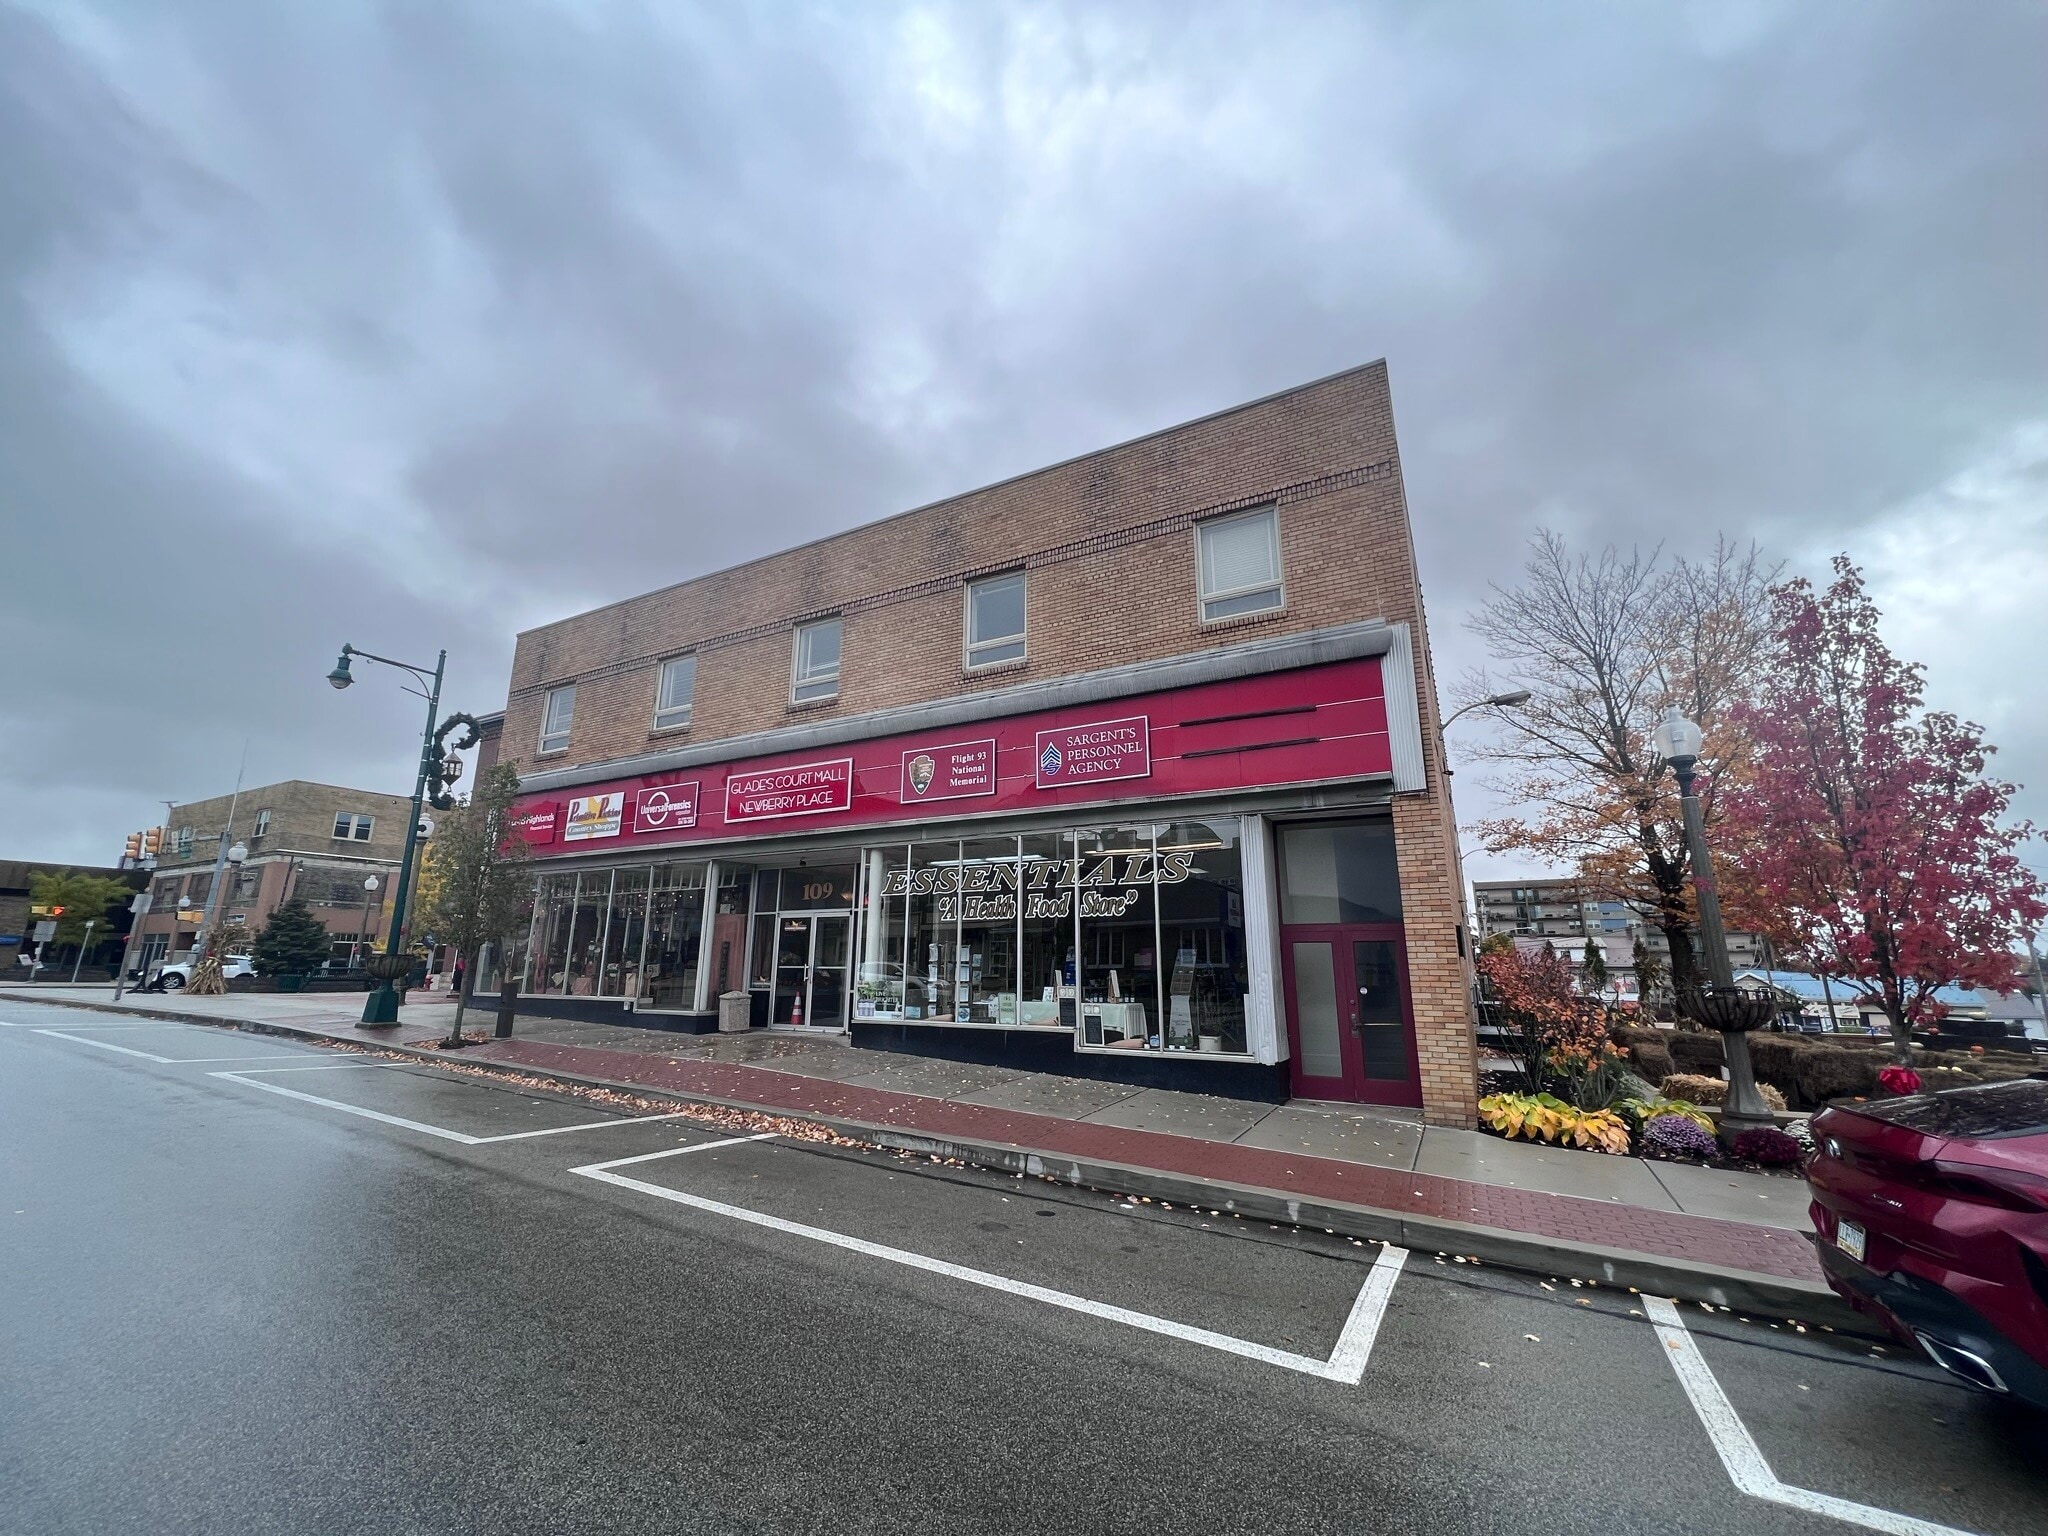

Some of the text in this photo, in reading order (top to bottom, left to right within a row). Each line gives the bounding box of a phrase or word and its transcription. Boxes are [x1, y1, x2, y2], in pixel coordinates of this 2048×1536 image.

[1067, 727, 1136, 747] SARGENT'S
[951, 751, 987, 764] Flight 93
[1067, 741, 1143, 761] PERSONNEL
[952, 763, 985, 775] National
[1067, 758, 1122, 775] AGENCY
[775, 771, 813, 789] COURT
[814, 768, 847, 783] MALL
[949, 775, 987, 787] Memorial
[739, 790, 834, 814] NEWBERRY PLACE
[568, 823, 617, 833] Country Shoppe
[880, 851, 1194, 897] ESSENTIALS
[801, 882, 834, 901] 109
[962, 893, 1017, 921] Health
[1025, 891, 1072, 919] Food
